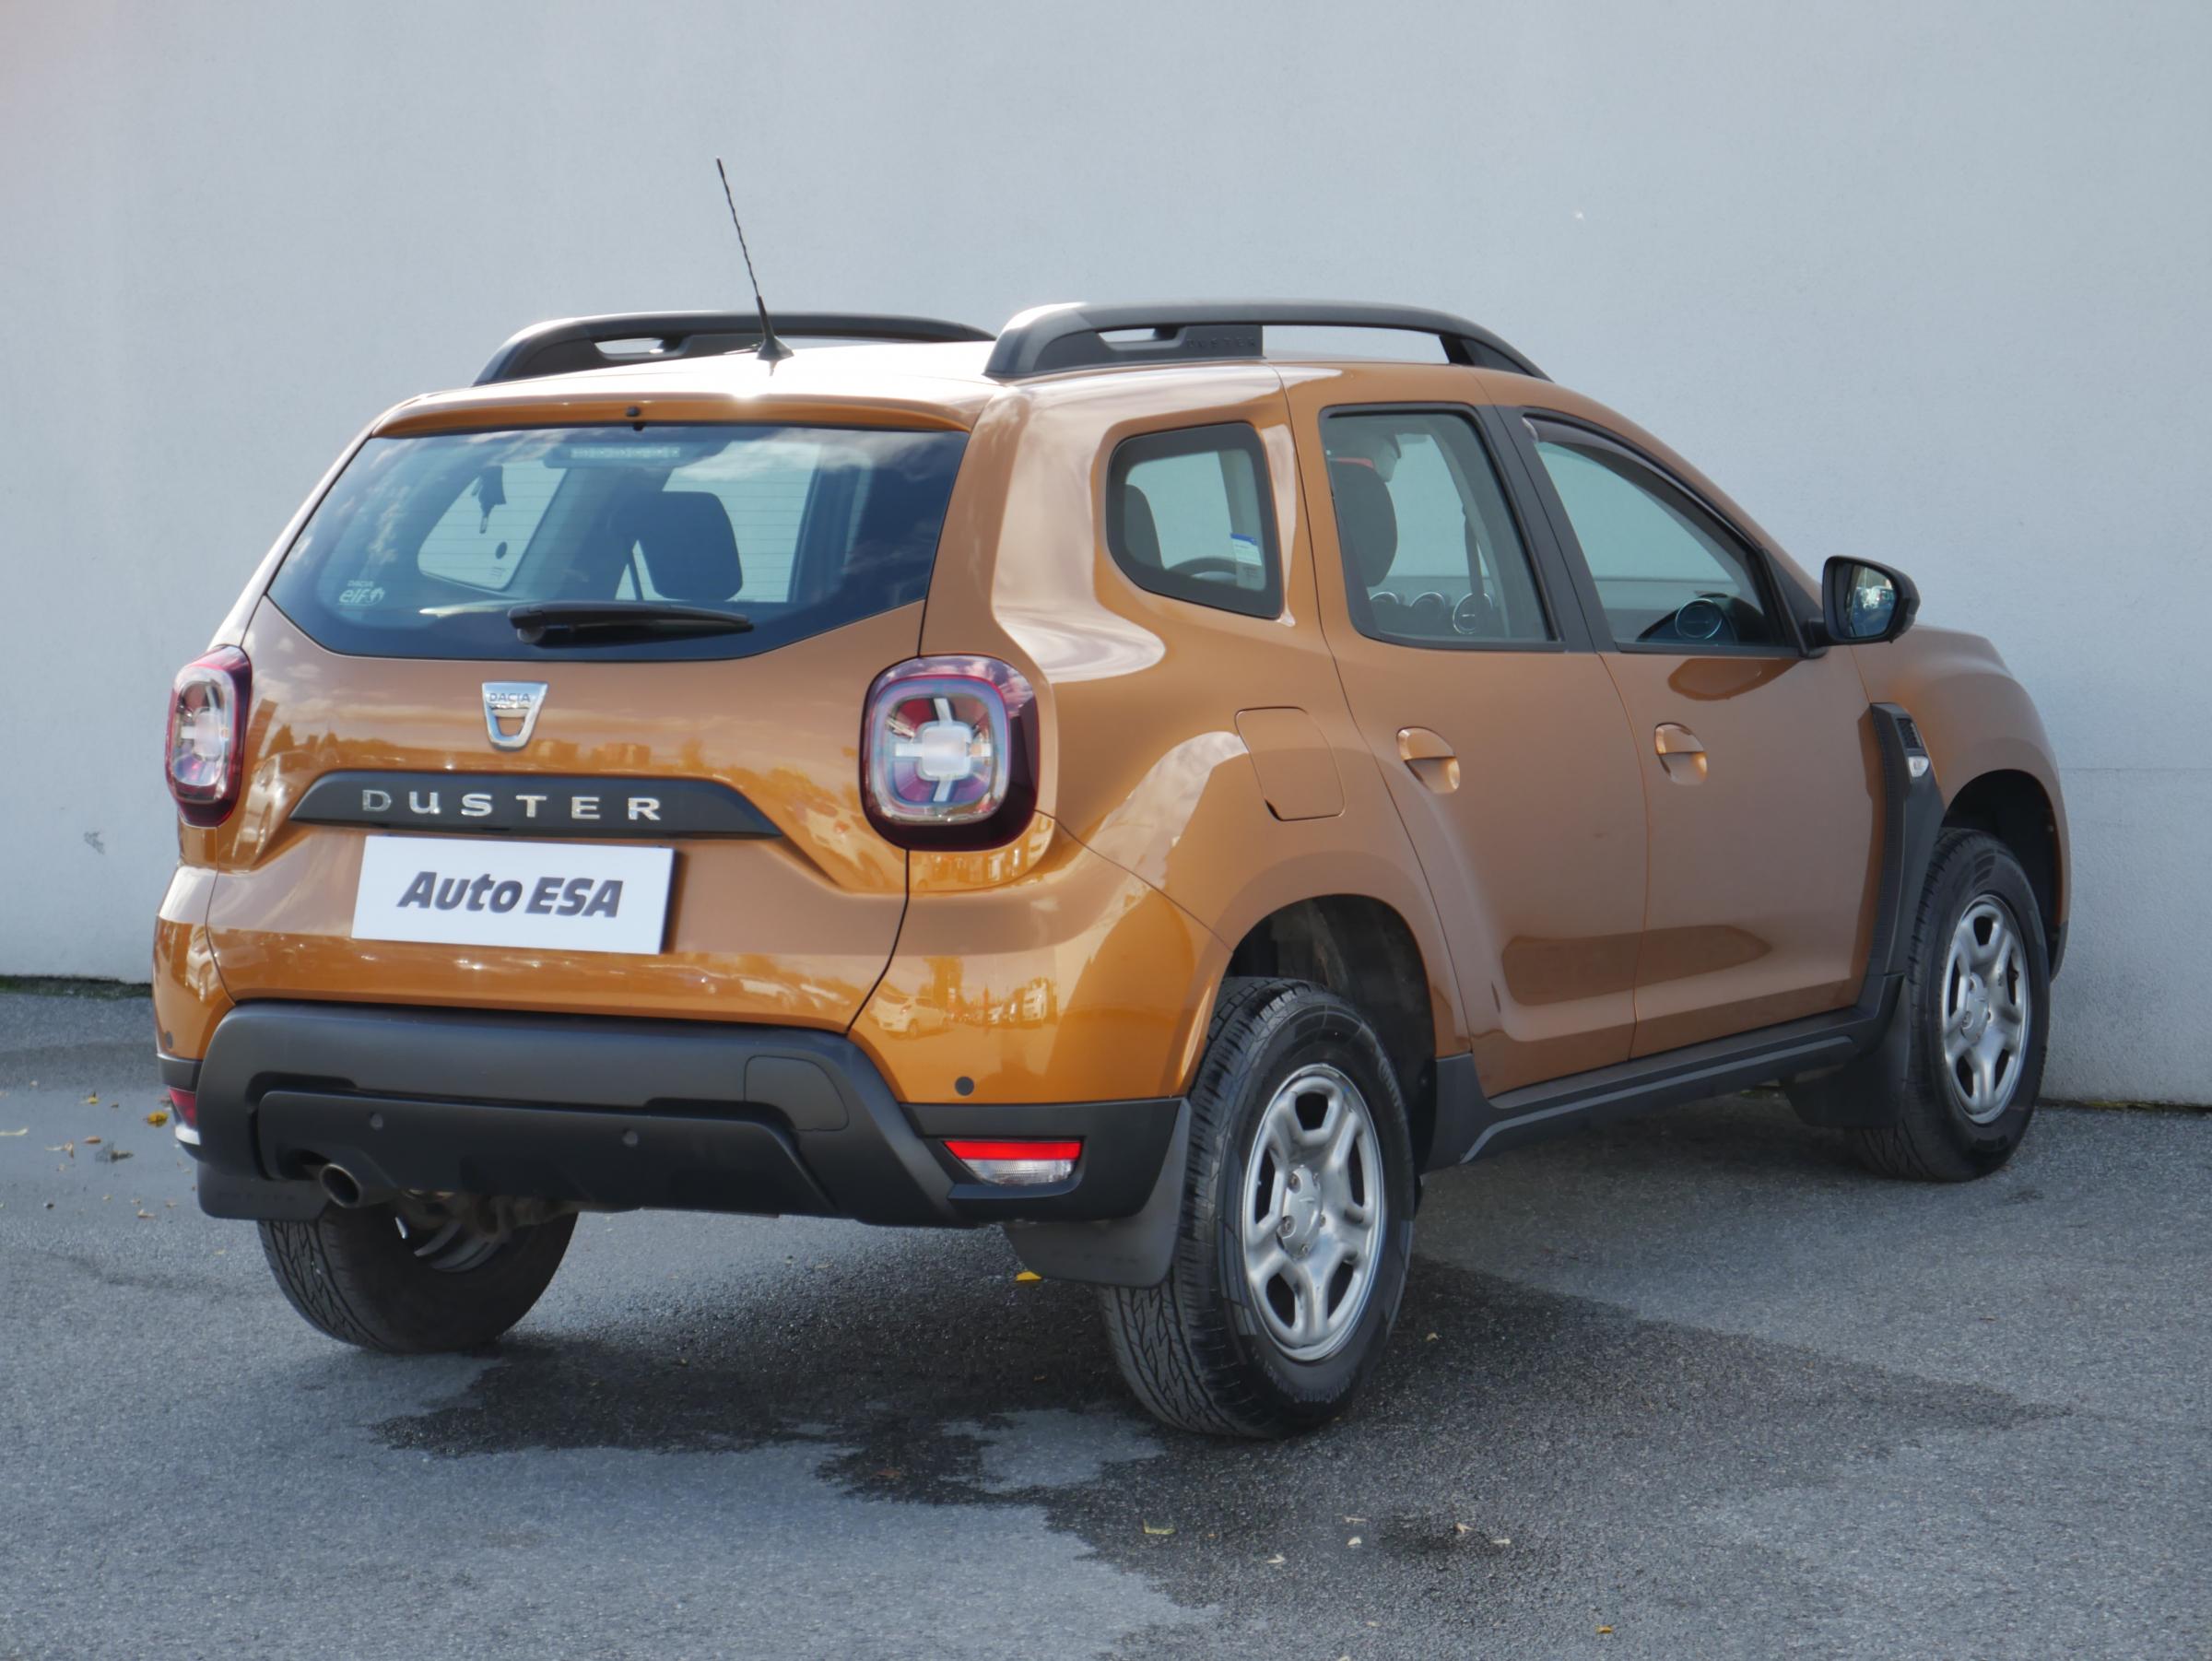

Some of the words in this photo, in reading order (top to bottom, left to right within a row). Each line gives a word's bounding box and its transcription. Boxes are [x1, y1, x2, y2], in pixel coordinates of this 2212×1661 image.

[488, 692, 531, 701] DACIA
[362, 789, 661, 820] DUSTER
[397, 871, 522, 913] Auto
[524, 877, 623, 917] ESA
